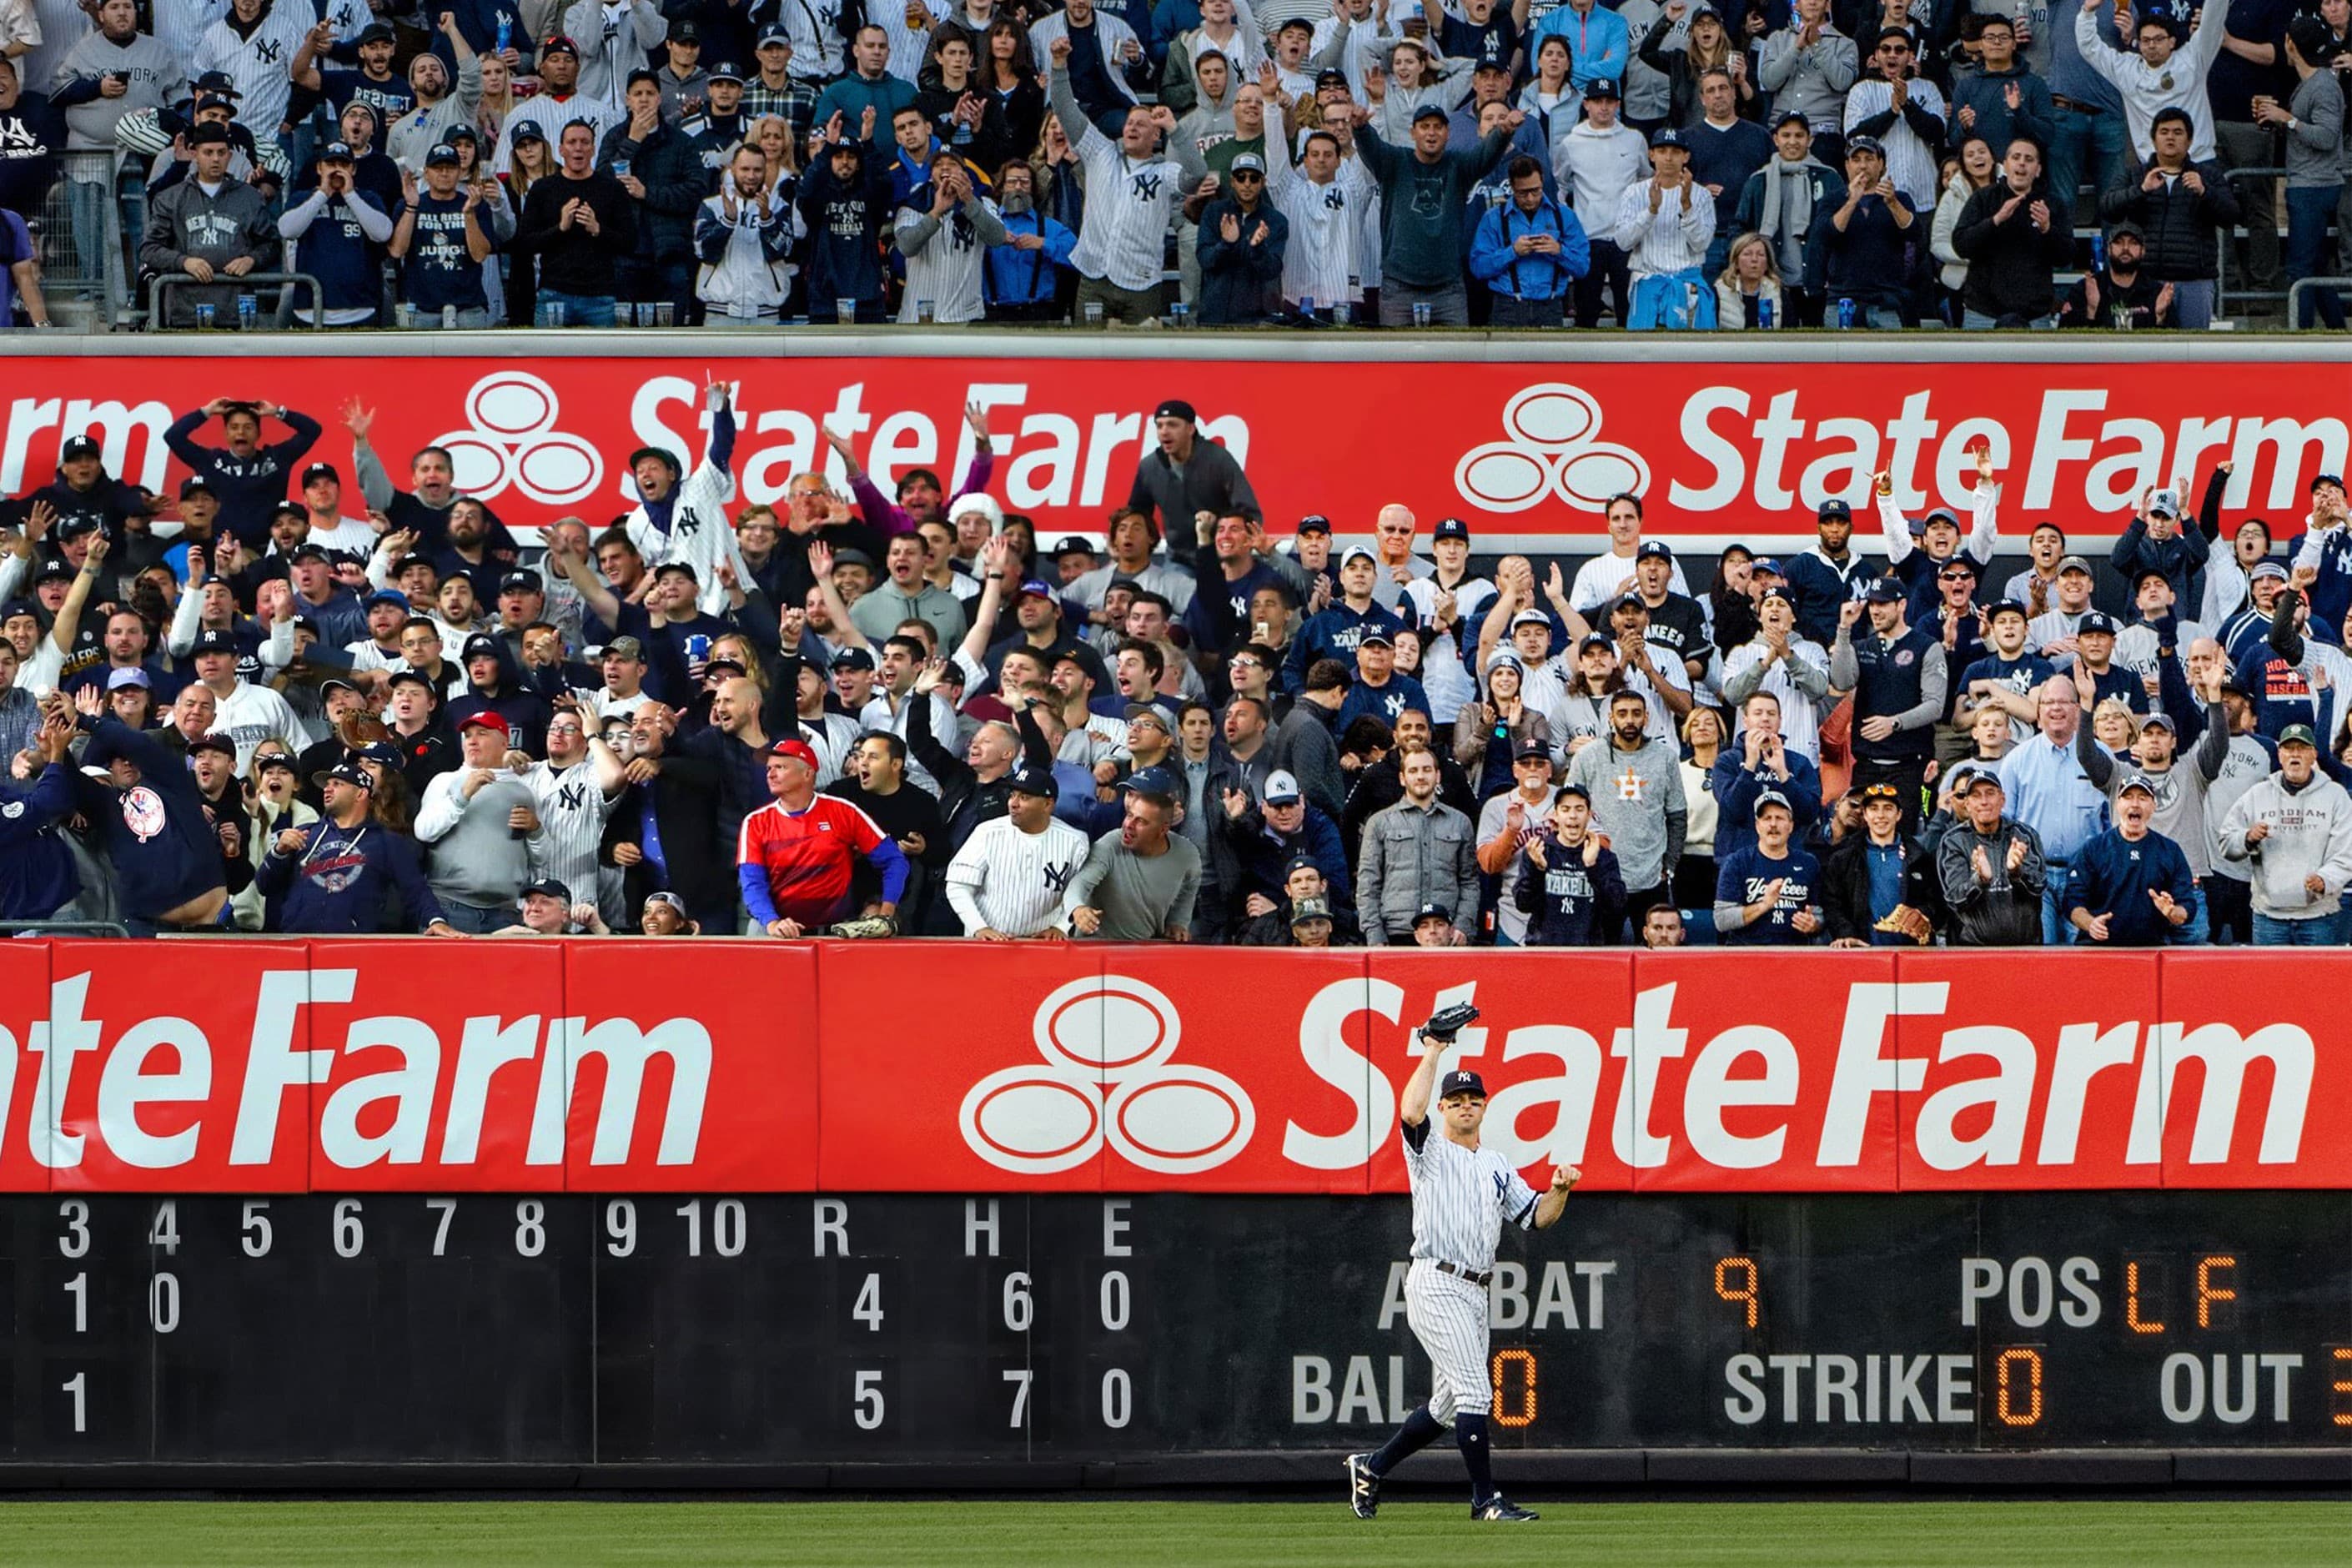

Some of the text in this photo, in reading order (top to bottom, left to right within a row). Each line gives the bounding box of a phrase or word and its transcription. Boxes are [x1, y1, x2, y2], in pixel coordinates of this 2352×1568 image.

[2031, 9, 2047, 22] YO
[255, 38, 282, 65] NY
[1598, 79, 1609, 90] NY
[1664, 128, 1676, 141] NY
[1133, 173, 1162, 202] NY
[1324, 188, 1344, 210] NY
[418, 221, 442, 231] FOR
[419, 213, 438, 223] ALL
[203, 229, 219, 245] NY
[344, 223, 360, 237] 99
[442, 260, 455, 270] 99
[0, 399, 173, 495] rm
[950, 384, 1249, 509] Far
[1669, 387, 2349, 513] State Farm
[677, 506, 700, 536] NY
[1445, 519, 1457, 530] NY
[1648, 542, 1660, 552] NY
[47, 560, 59, 570] NY
[1870, 578, 1882, 591] NY
[1229, 596, 1247, 618] NY
[1371, 625, 1383, 635] NY
[2092, 615, 2103, 626] NY
[204, 631, 217, 642] NY
[1643, 624, 1686, 647] NKEES
[2011, 668, 2033, 697] NY
[2265, 683, 2309, 696] BASEBA
[1385, 692, 1408, 719] NY
[2230, 749, 2260, 769] YORK
[1016, 768, 1029, 781] NY
[559, 782, 586, 811] NY
[1275, 780, 1288, 792] NY
[2260, 807, 2326, 821] FORDHAM
[1043, 861, 1071, 892] NY
[1746, 877, 1809, 902] Yakees
[1421, 902, 1435, 913] NY
[1561, 897, 1575, 914] NY
[1772, 911, 1785, 924] NY
[0, 969, 712, 1168] te Farm
[1458, 1070, 1472, 1083] NY
[1817, 983, 2315, 1170] Farm
[59, 1199, 1133, 1258] 3 4 5 6 7 8 9 10 R H E
[64, 1270, 1130, 1333] 1 0 4 6 0
[1490, 1260, 1618, 1330] BAT
[1714, 1257, 1757, 1329] 9
[1961, 1257, 2102, 1328] POS
[1293, 1349, 1537, 1427] BAL 0
[1723, 1349, 2043, 1426] STRIKE 0
[2160, 1352, 2304, 1424] OUT
[63, 1368, 1132, 1432] 1 5 7 0
